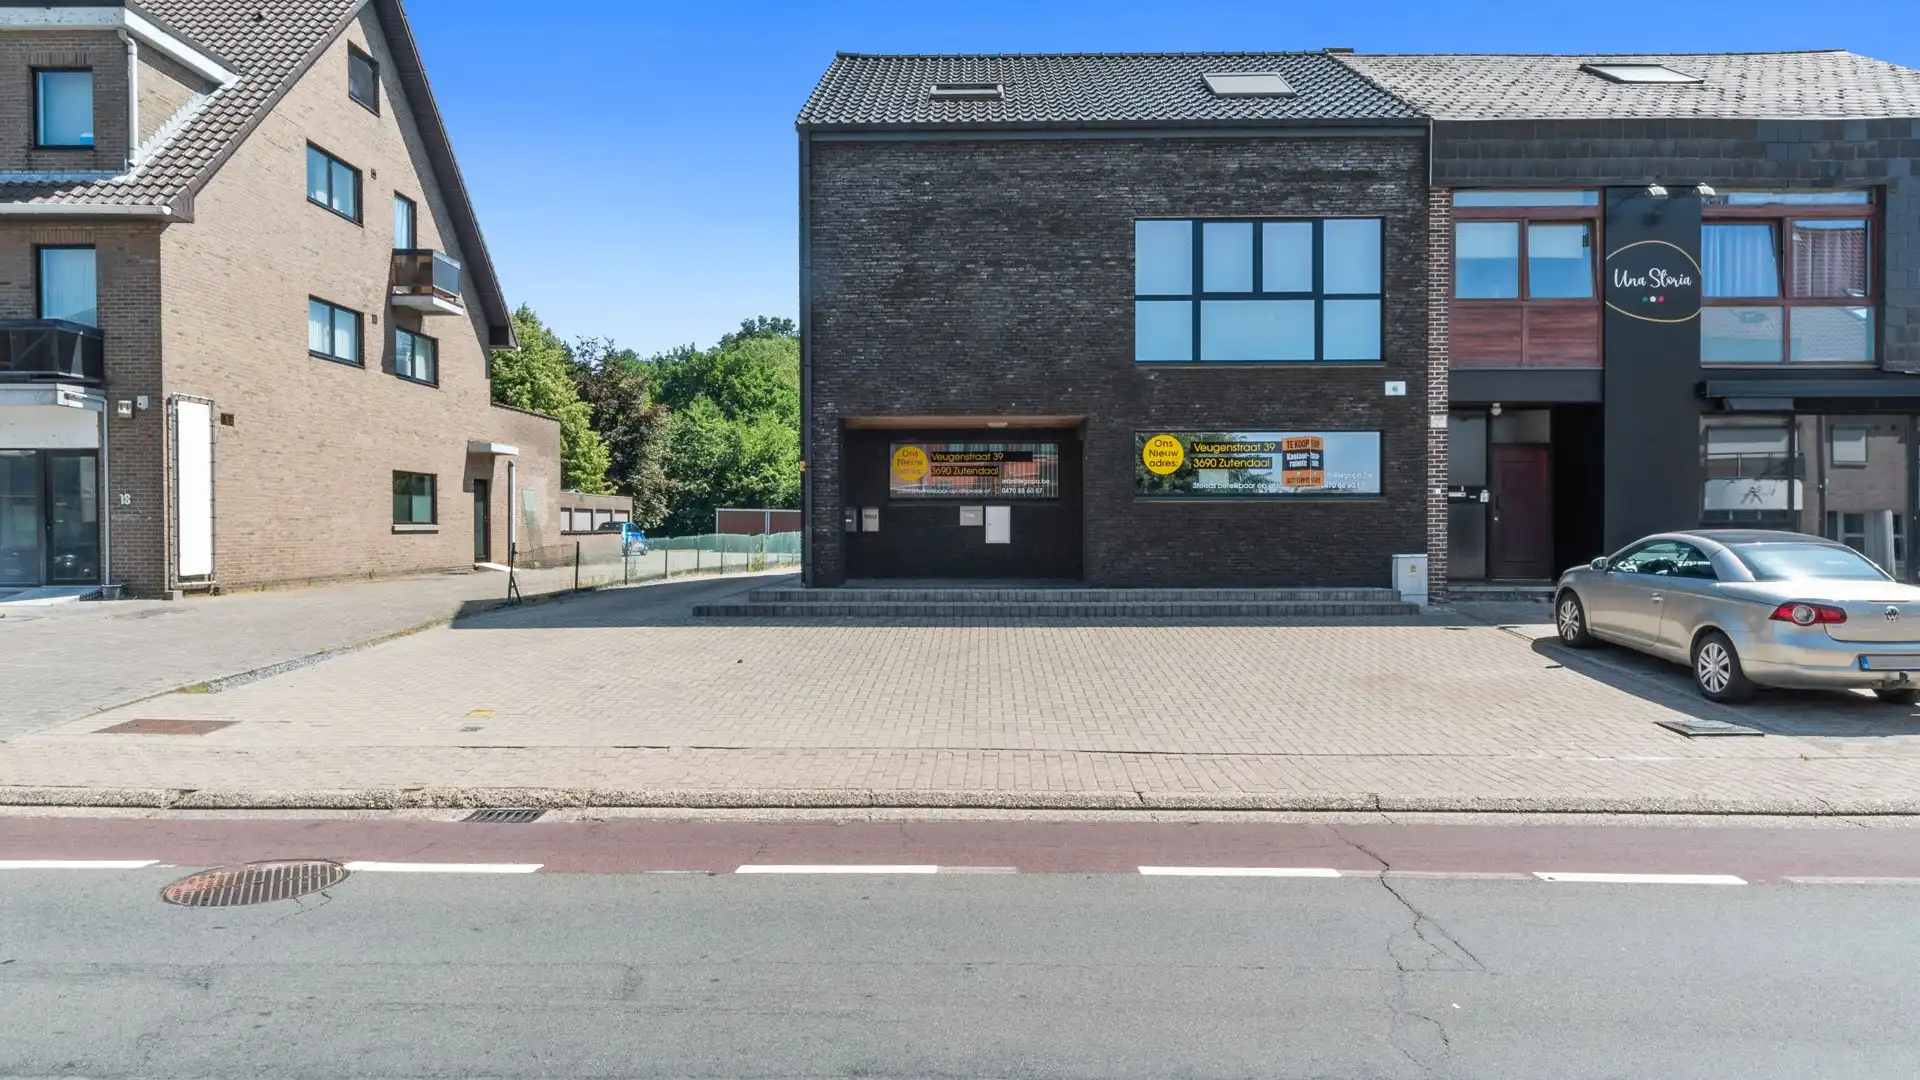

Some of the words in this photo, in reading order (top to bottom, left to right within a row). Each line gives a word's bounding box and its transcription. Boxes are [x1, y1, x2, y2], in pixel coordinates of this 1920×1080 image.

[1614, 268, 1647, 288] Una
[1648, 267, 1692, 288] Storia
[1154, 440, 1173, 448] Ons
[1193, 443, 1260, 454] Veugenstraat
[1263, 442, 1275, 452] 39
[1287, 440, 1294, 449] TE
[1295, 439, 1310, 448] KOOP
[931, 452, 991, 461] Veugenstraat
[993, 452, 1004, 460] 39
[1148, 449, 1179, 458] Nieuw
[1148, 458, 1179, 468] adres:
[1193, 458, 1217, 468] 3690
[1219, 458, 1270, 468] Zutendaal
[931, 466, 951, 475] 3690
[953, 466, 999, 475] Zutendaal
[119, 493, 131, 505] 18
